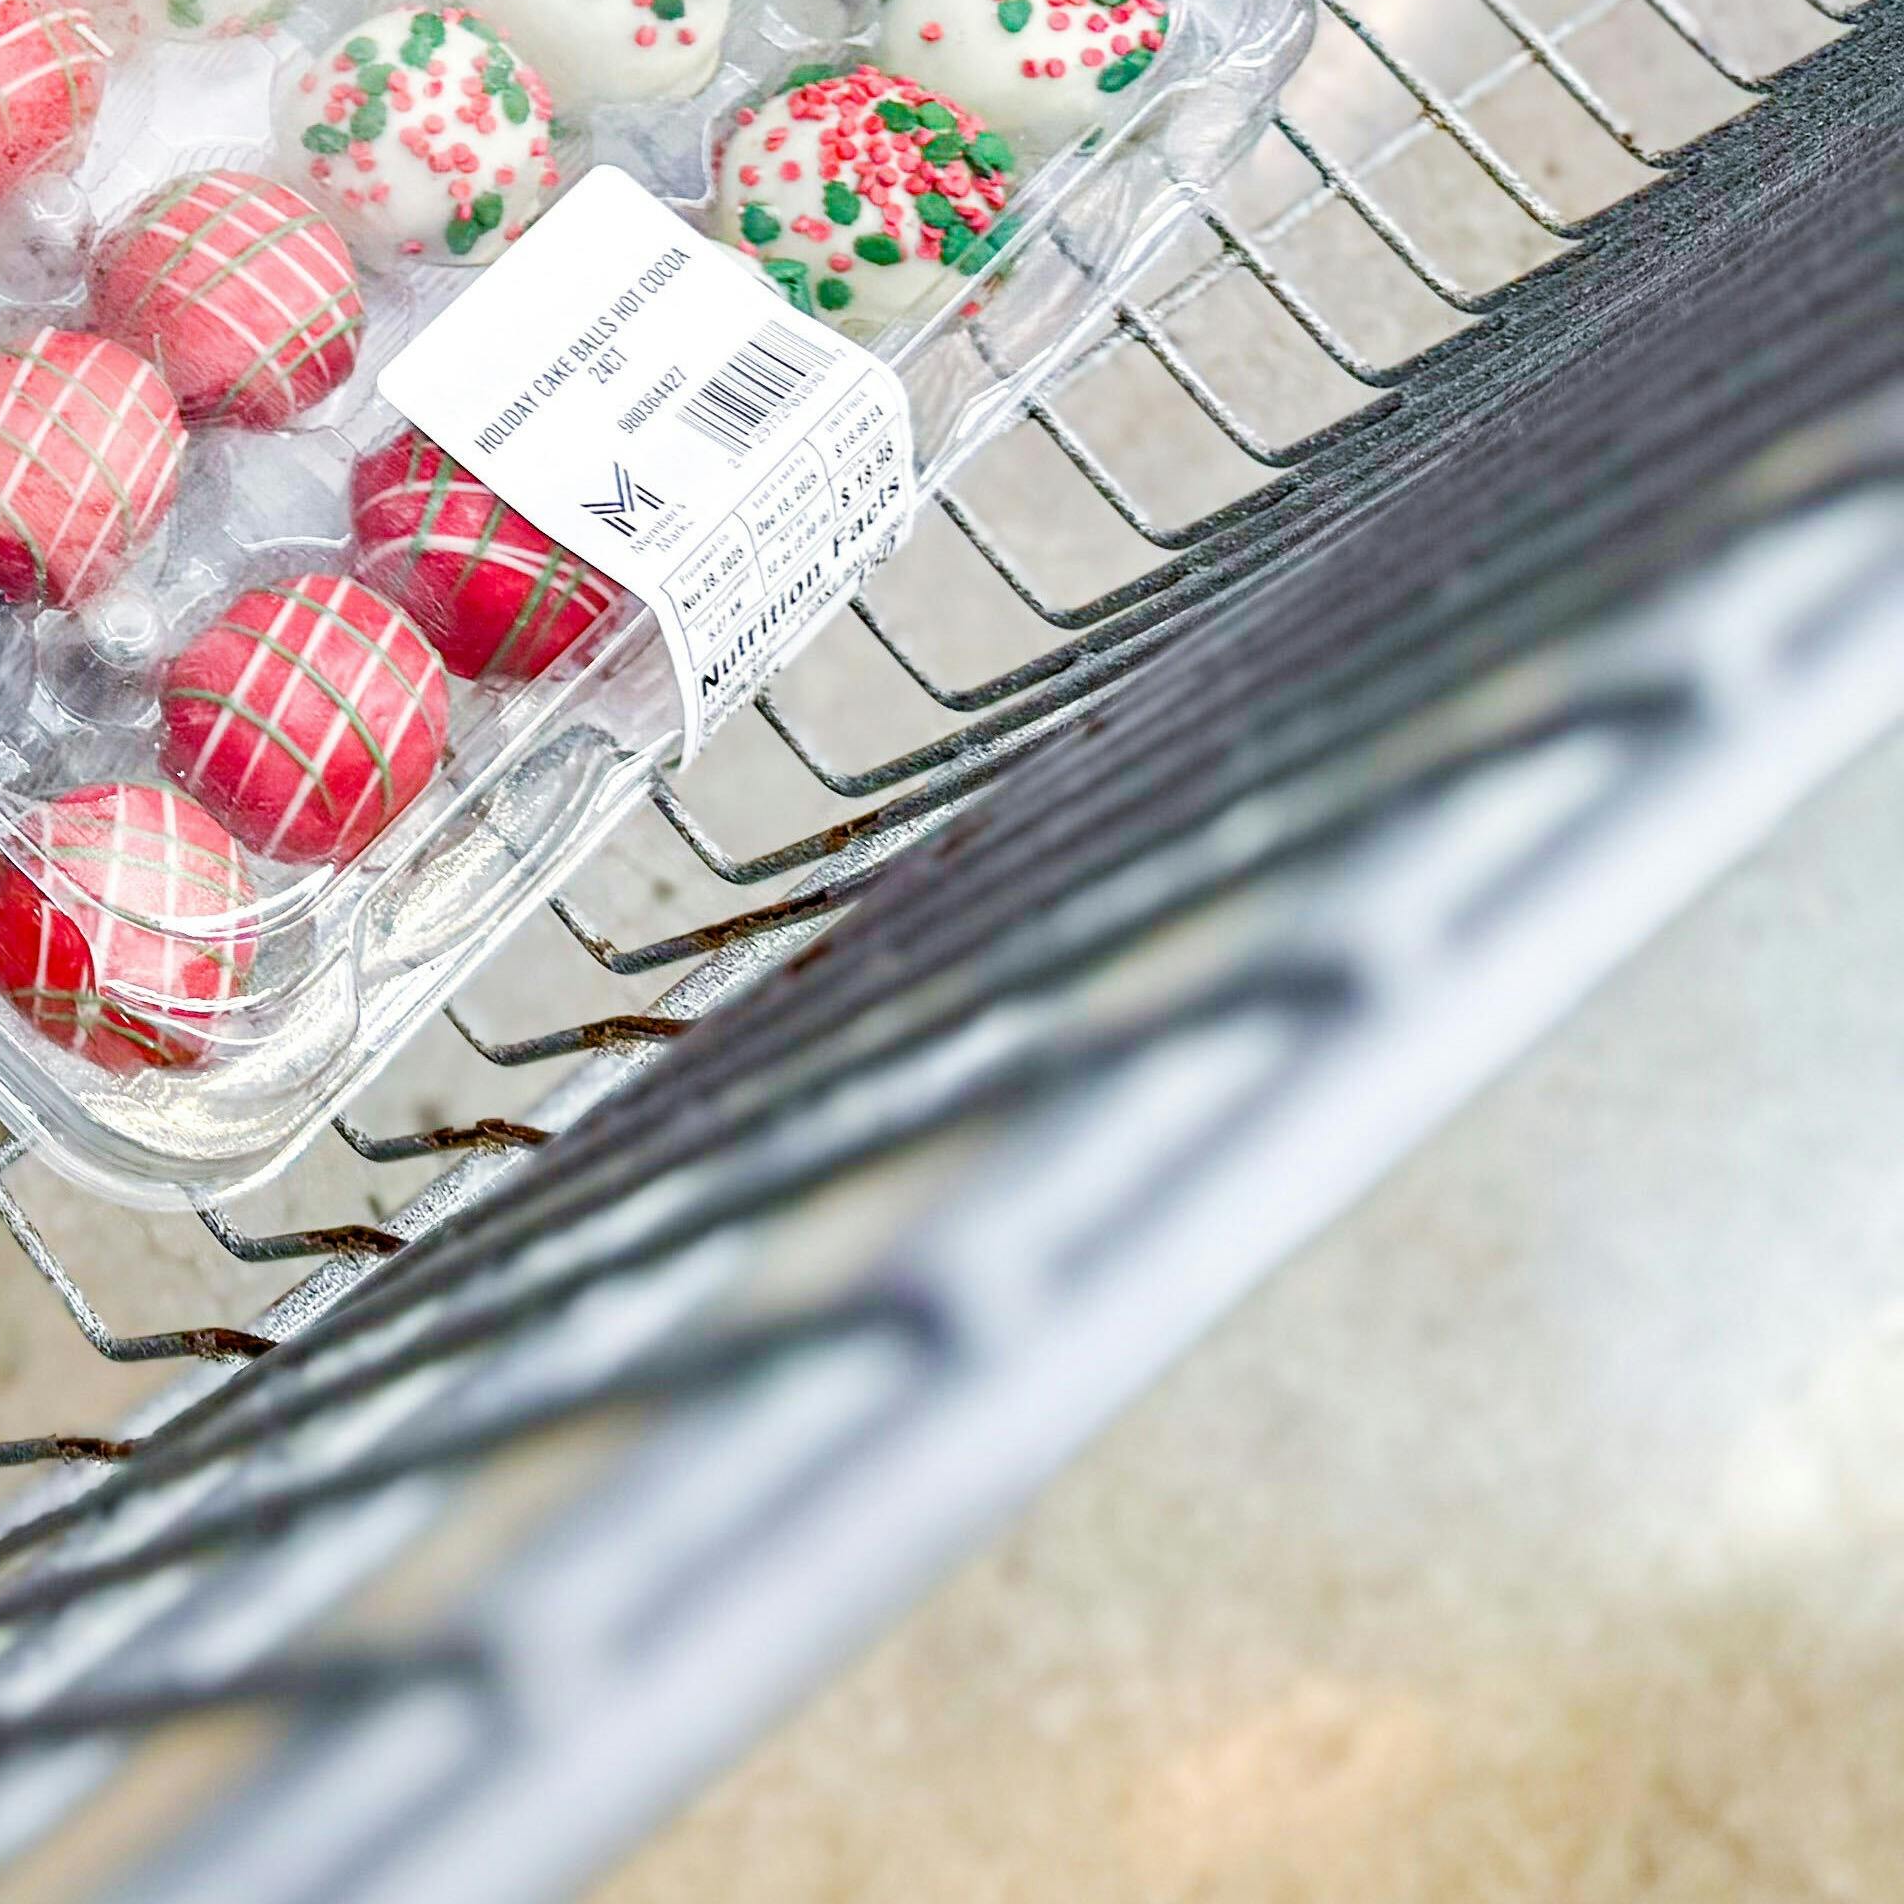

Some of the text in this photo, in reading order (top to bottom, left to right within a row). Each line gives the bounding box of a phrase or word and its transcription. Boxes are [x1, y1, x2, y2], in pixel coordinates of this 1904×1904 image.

[474, 248, 691, 454] HOLIDAY CAKE BALLS HOT COCOA
[588, 347, 627, 384] 24CT
[618, 366, 686, 434] 980364427
[836, 486, 853, 507] $
[853, 440, 896, 490] 18.98
[755, 513, 776, 535] Dec
[680, 590, 703, 612] Nov
[702, 563, 820, 697] Nutrition
[828, 475, 901, 558] Facts
